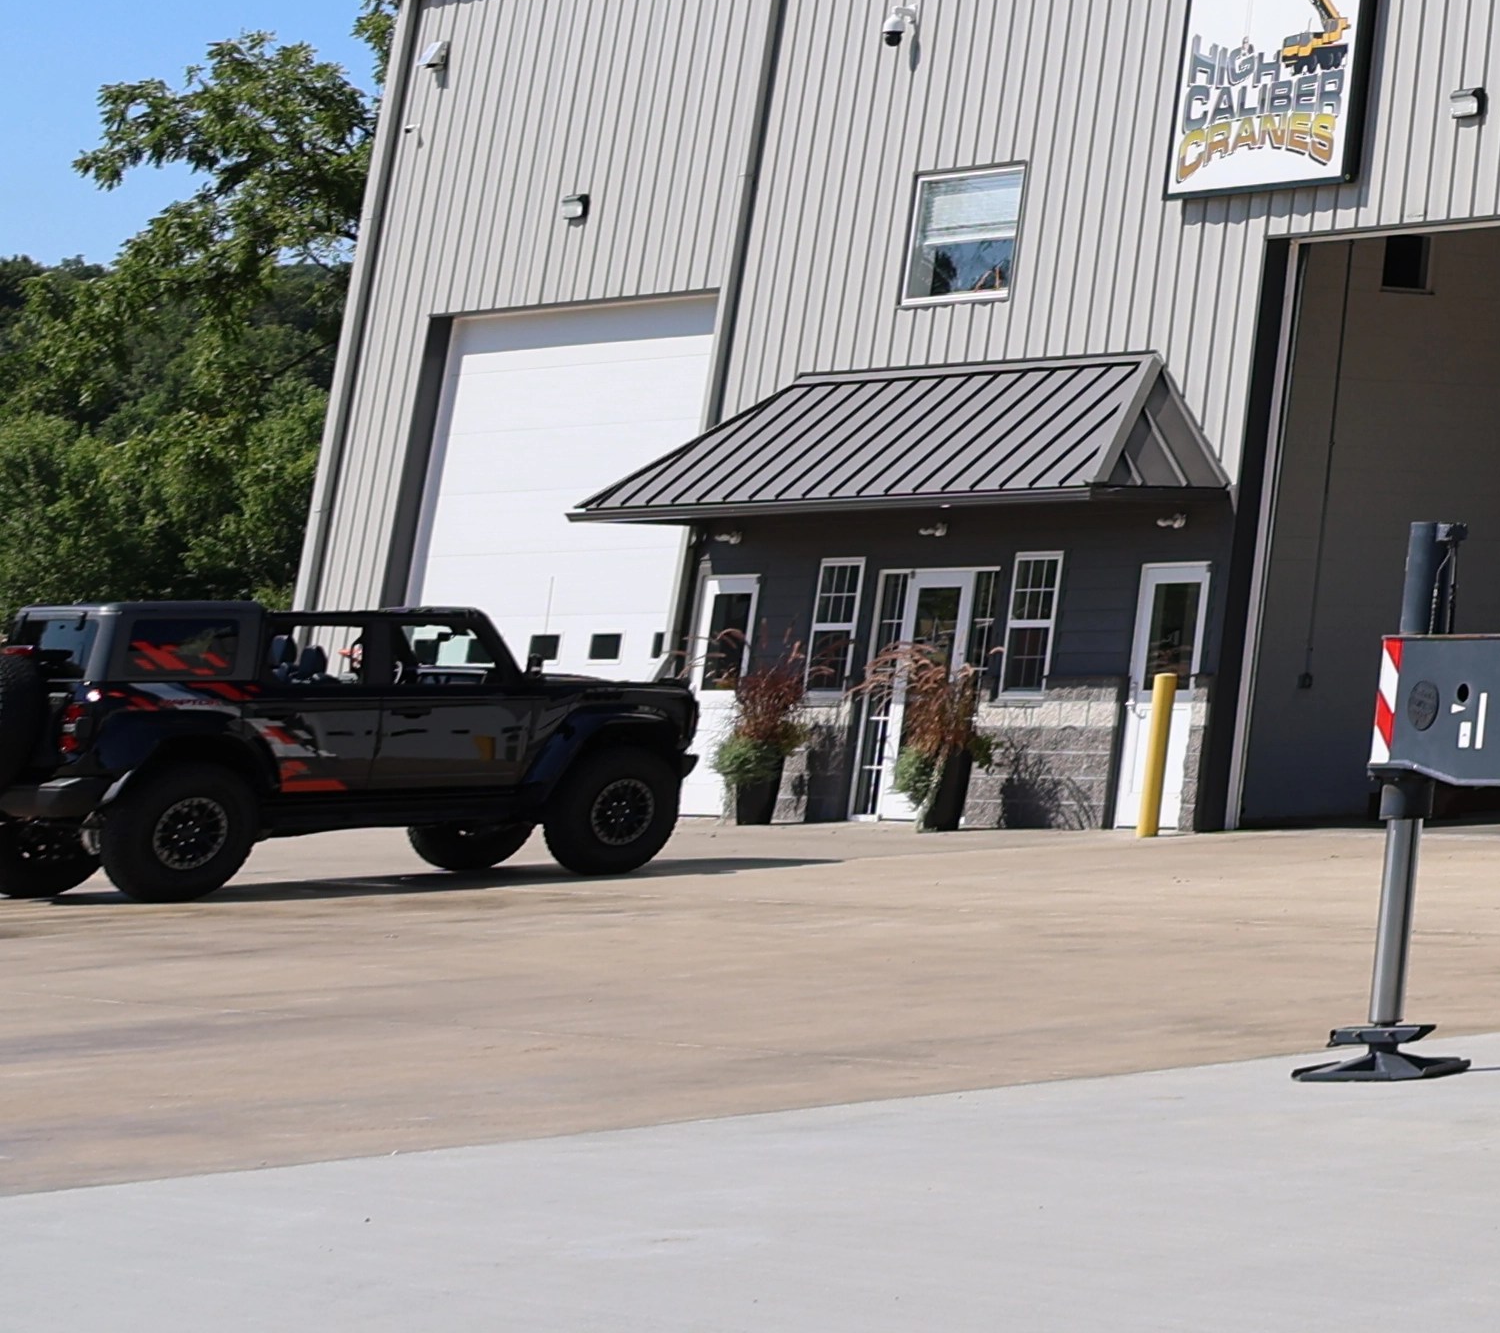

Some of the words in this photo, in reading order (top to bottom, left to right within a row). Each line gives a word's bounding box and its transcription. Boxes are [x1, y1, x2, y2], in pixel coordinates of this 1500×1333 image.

[1189, 34, 1281, 87] HIGH
[1183, 69, 1345, 134] CALIBER
[1176, 112, 1336, 183] CRANES
